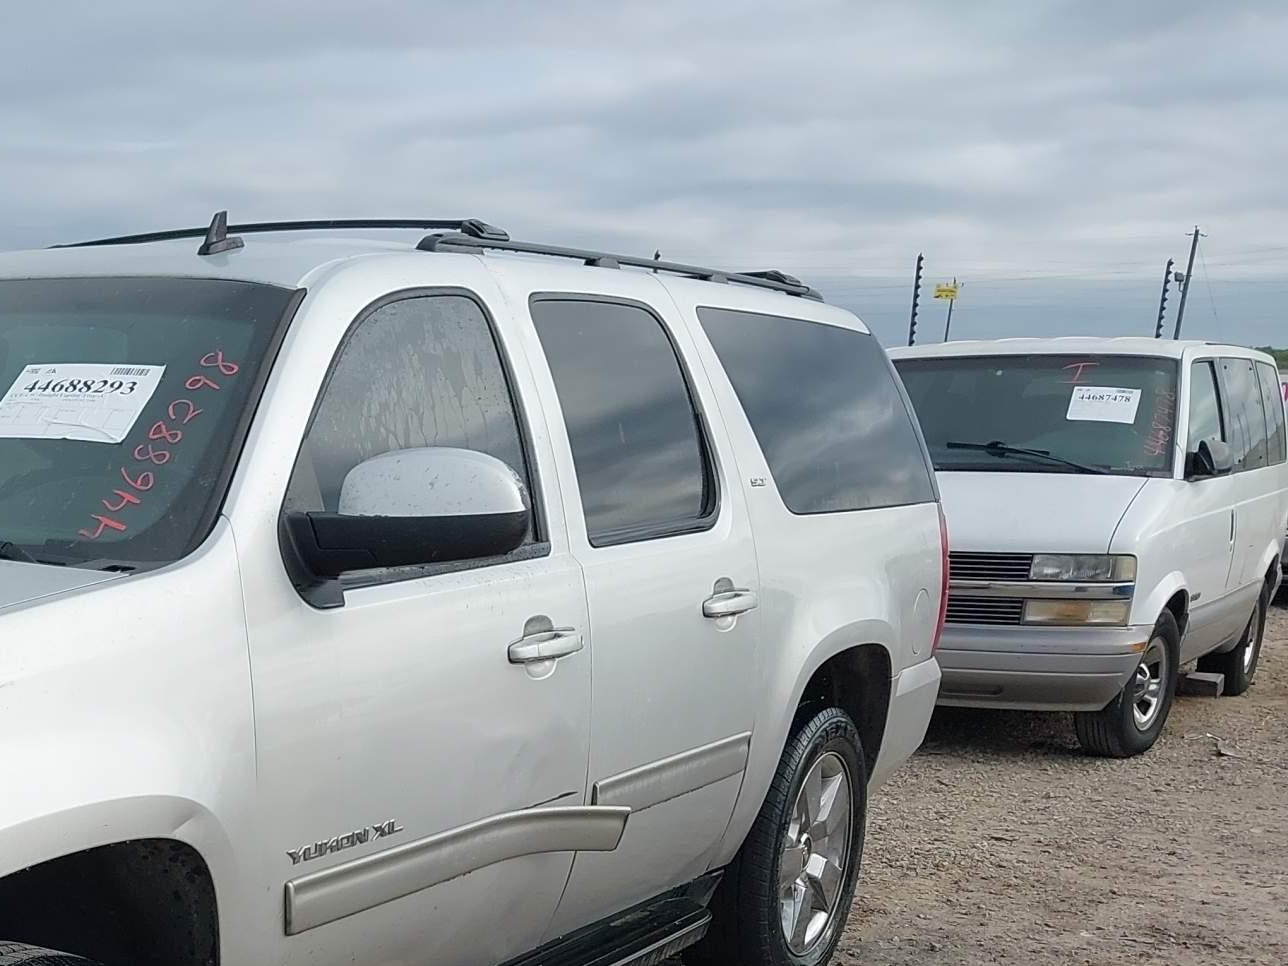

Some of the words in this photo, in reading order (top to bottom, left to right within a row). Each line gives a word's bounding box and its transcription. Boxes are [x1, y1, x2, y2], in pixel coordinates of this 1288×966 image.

[23, 378, 138, 395] 44688293
[1078, 393, 1131, 402] 44687478
[286, 827, 369, 865] YUKON
[372, 819, 404, 841] XL
